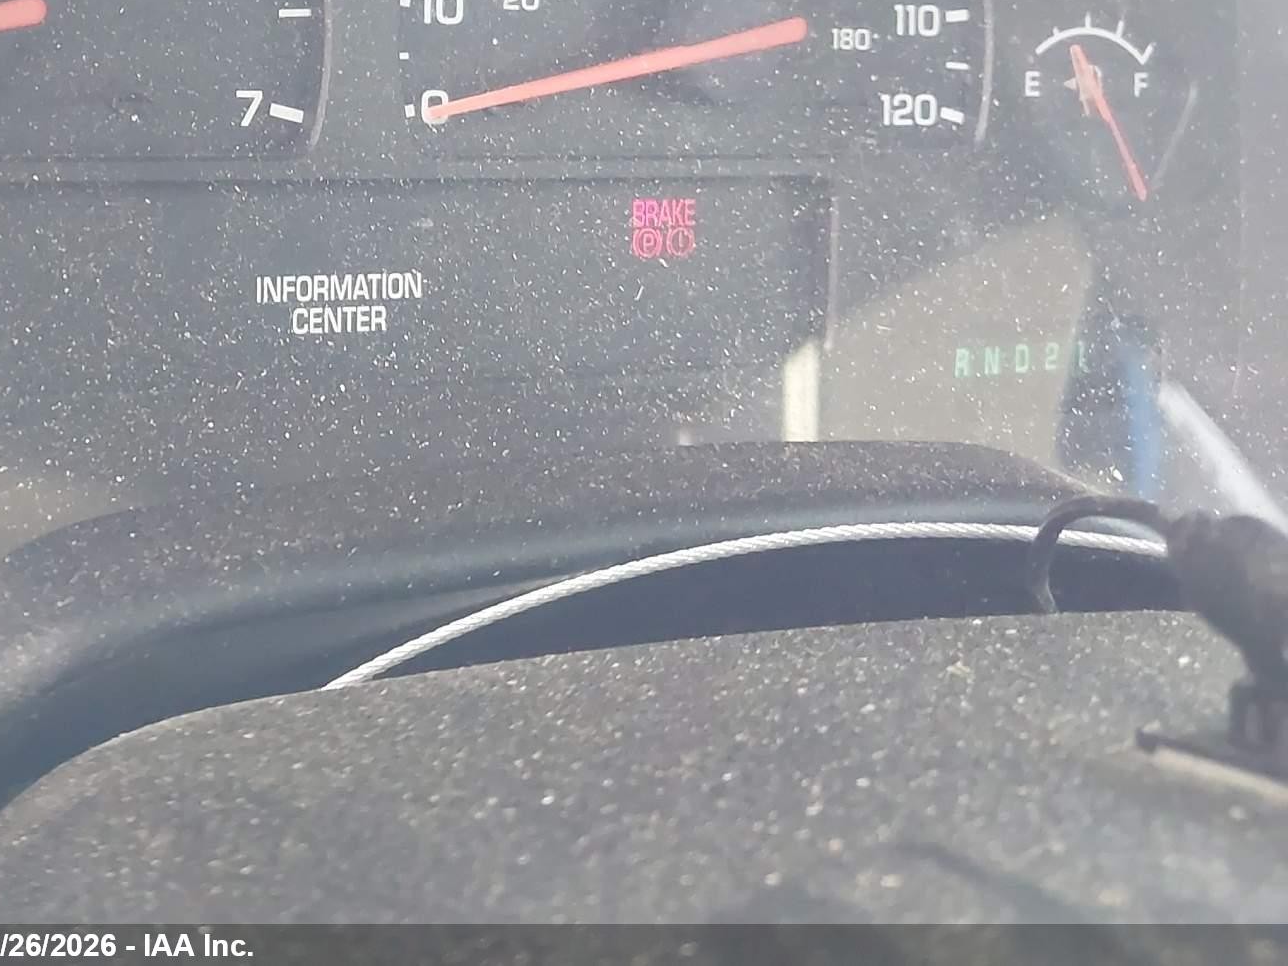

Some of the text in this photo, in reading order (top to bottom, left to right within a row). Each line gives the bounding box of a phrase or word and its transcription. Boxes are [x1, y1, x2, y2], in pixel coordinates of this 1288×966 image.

[895, 4, 940, 38] 110
[832, 28, 870, 51] 180
[1025, 71, 1041, 97] E
[1134, 72, 1148, 97] F
[235, 90, 263, 128] 7
[420, 90, 448, 125] 0
[881, 94, 937, 126] 120
[632, 199, 696, 227] BRAKE
[256, 271, 423, 305] INFORMATION
[292, 305, 388, 335] CENTER
[954, 348, 970, 377] R
[983, 346, 1000, 375] N
[1045, 342, 1060, 370] 2
